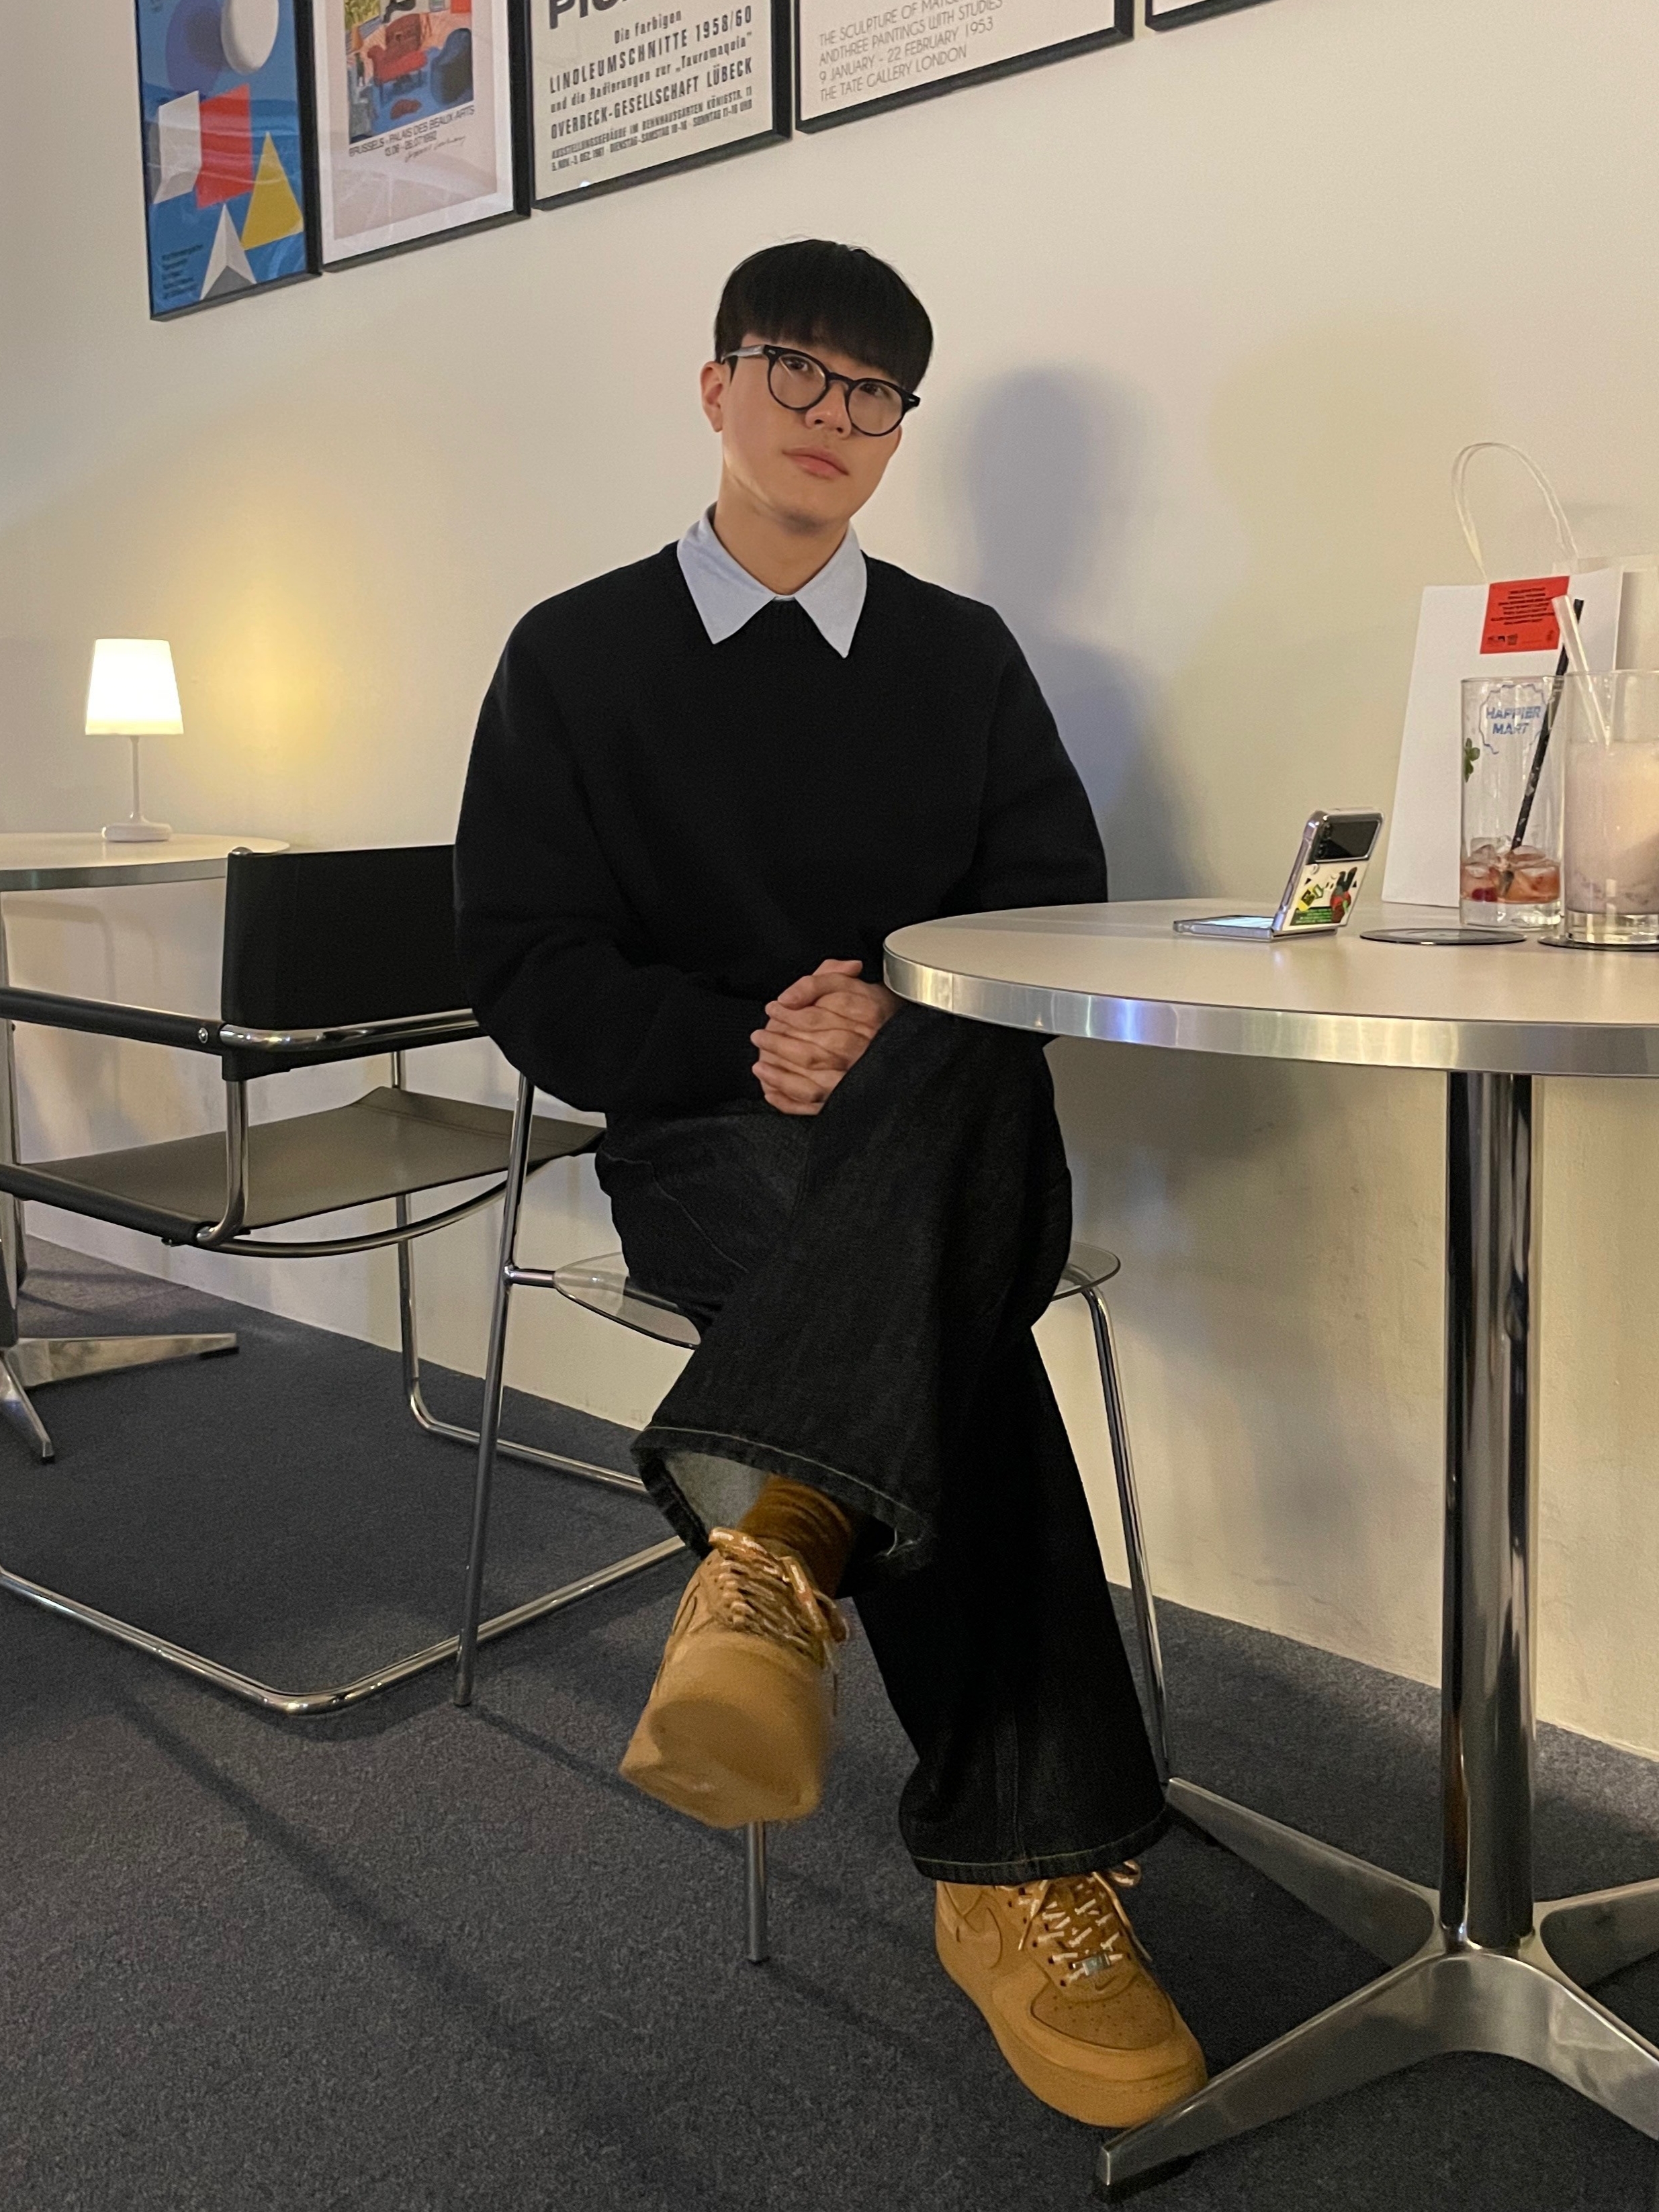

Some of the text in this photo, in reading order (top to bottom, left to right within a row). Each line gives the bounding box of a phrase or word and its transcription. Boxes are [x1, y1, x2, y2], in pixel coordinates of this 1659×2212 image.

[615, 11, 681, 44] Die farbigen
[820, 30, 836, 46] THE
[840, 9, 897, 40] SCULPTURE
[901, 2, 917, 19] OF
[872, 19, 926, 48] PAINTINGS
[928, 9, 954, 30] WITH
[958, 0, 1003, 20] STUDIES
[550, 5, 751, 93] LINOLEUMSCHNITTE 1958/60
[819, 71, 826, 84] 9
[830, 54, 875, 81] JANUARY
[887, 46, 901, 62] 22
[905, 27, 959, 56] FEBRUARY
[966, 16, 993, 37] 1953
[820, 44, 967, 101] THE TATE GALLERY LONDON
[551, 57, 752, 139] OVERBECK-GESELLSCHAFT LÜBECK
[551, 97, 567, 113] und
[572, 92, 585, 105] die
[1486, 706, 1541, 719] HAPPIER
